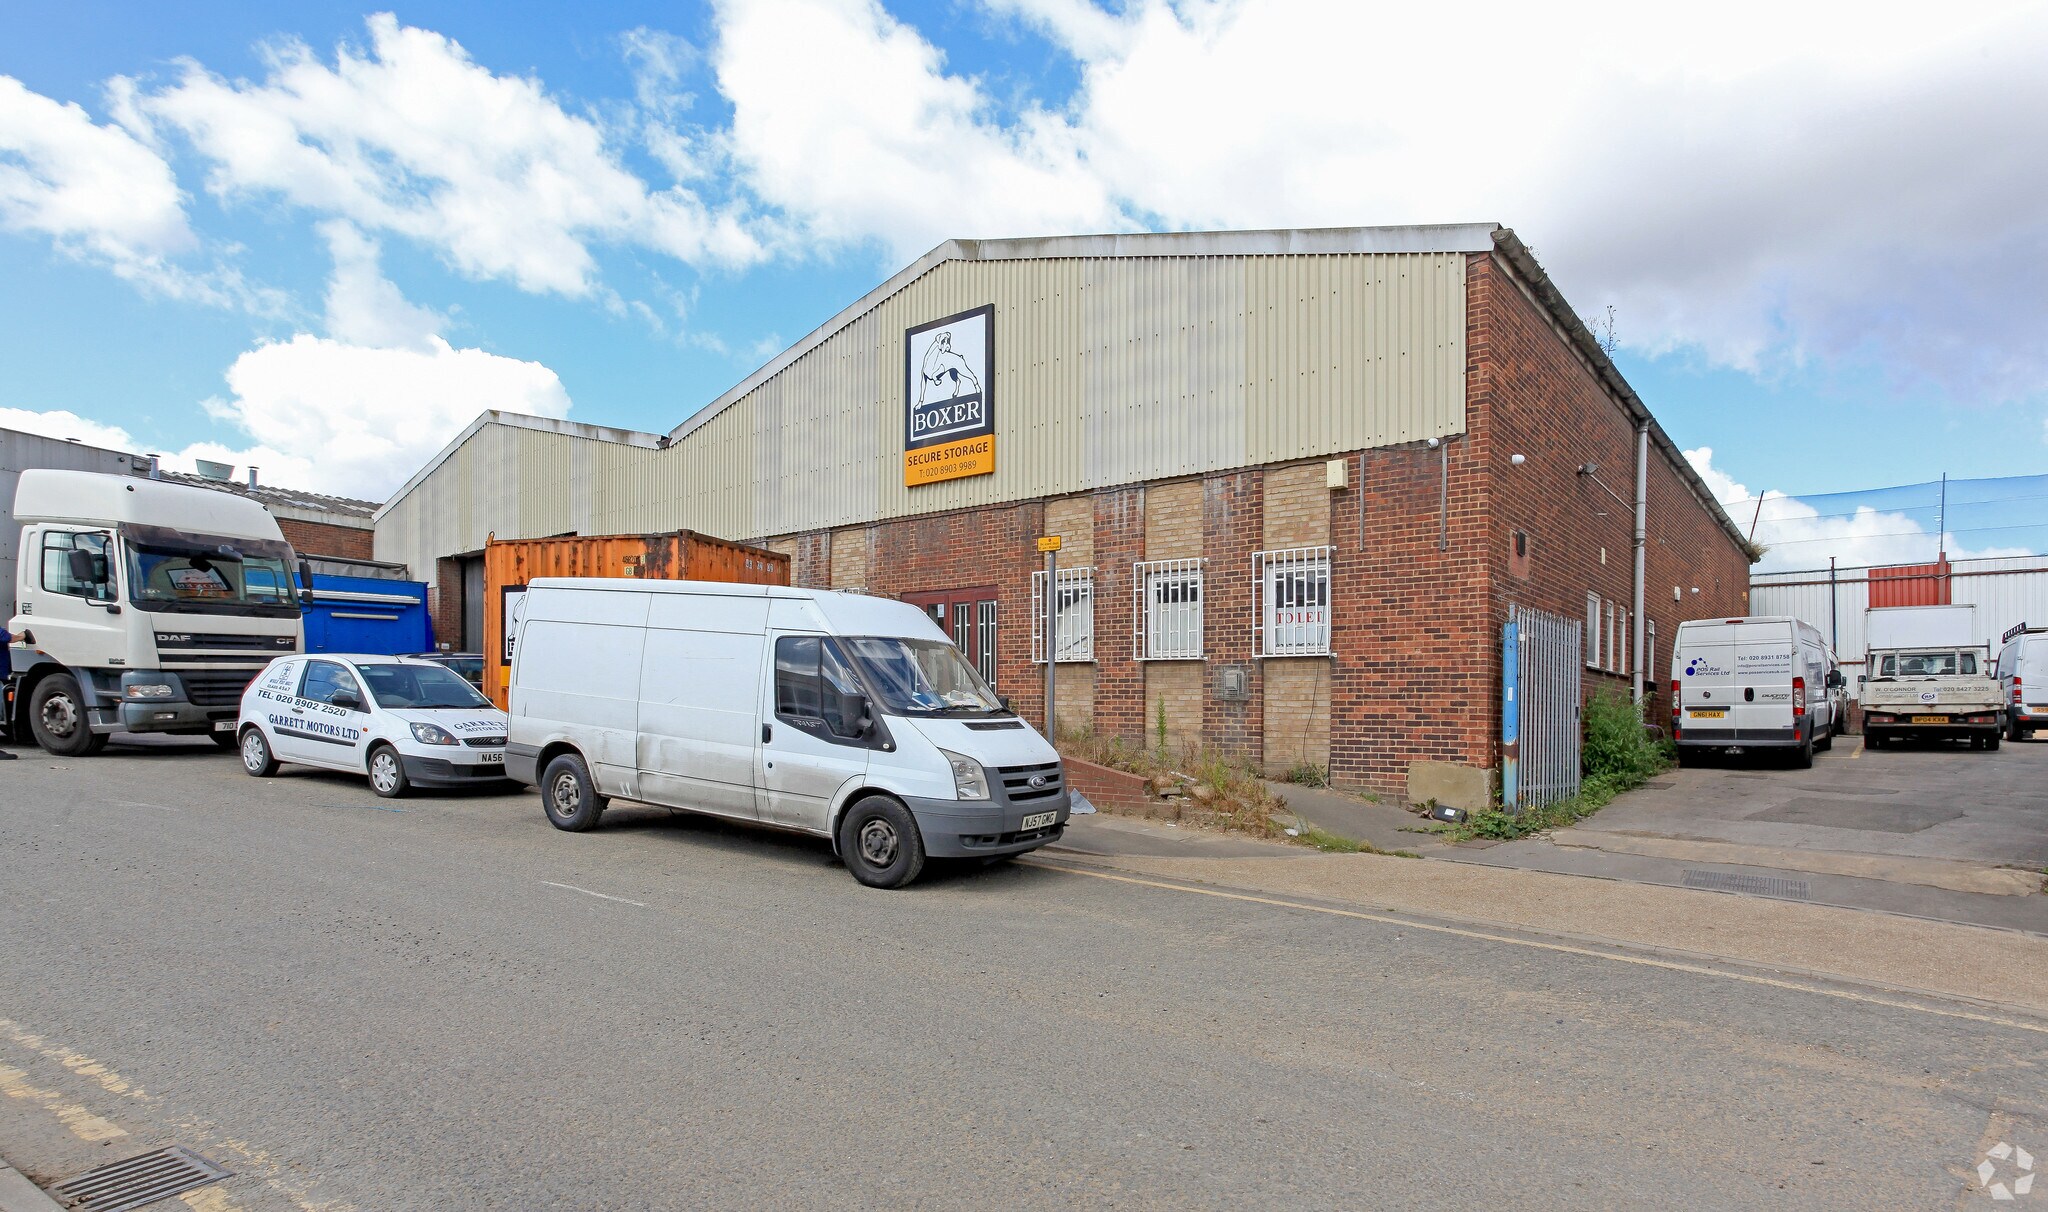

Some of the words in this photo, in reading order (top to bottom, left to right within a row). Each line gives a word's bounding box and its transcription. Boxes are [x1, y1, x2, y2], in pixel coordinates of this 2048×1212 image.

[914, 400, 981, 432] BOXER
[908, 449, 942, 467] SECURE
[944, 441, 989, 460] STORAGE
[925, 467, 939, 478] 020
[940, 463, 957, 475] 8903
[959, 459, 977, 471] 9989
[1276, 613, 1294, 624] TO
[1297, 611, 1322, 623] LET
[157, 634, 191, 642] DAF
[276, 637, 295, 645] CF
[258, 689, 274, 700] TEL:
[275, 694, 293, 704] 020
[294, 698, 320, 711] 8902
[321, 704, 347, 717] 2520
[268, 713, 305, 729] GARRETT
[306, 720, 340, 736] MOTORS
[341, 727, 360, 740] LTD
[481, 753, 503, 762] NA56
[1024, 815, 1041, 828] NJ57
